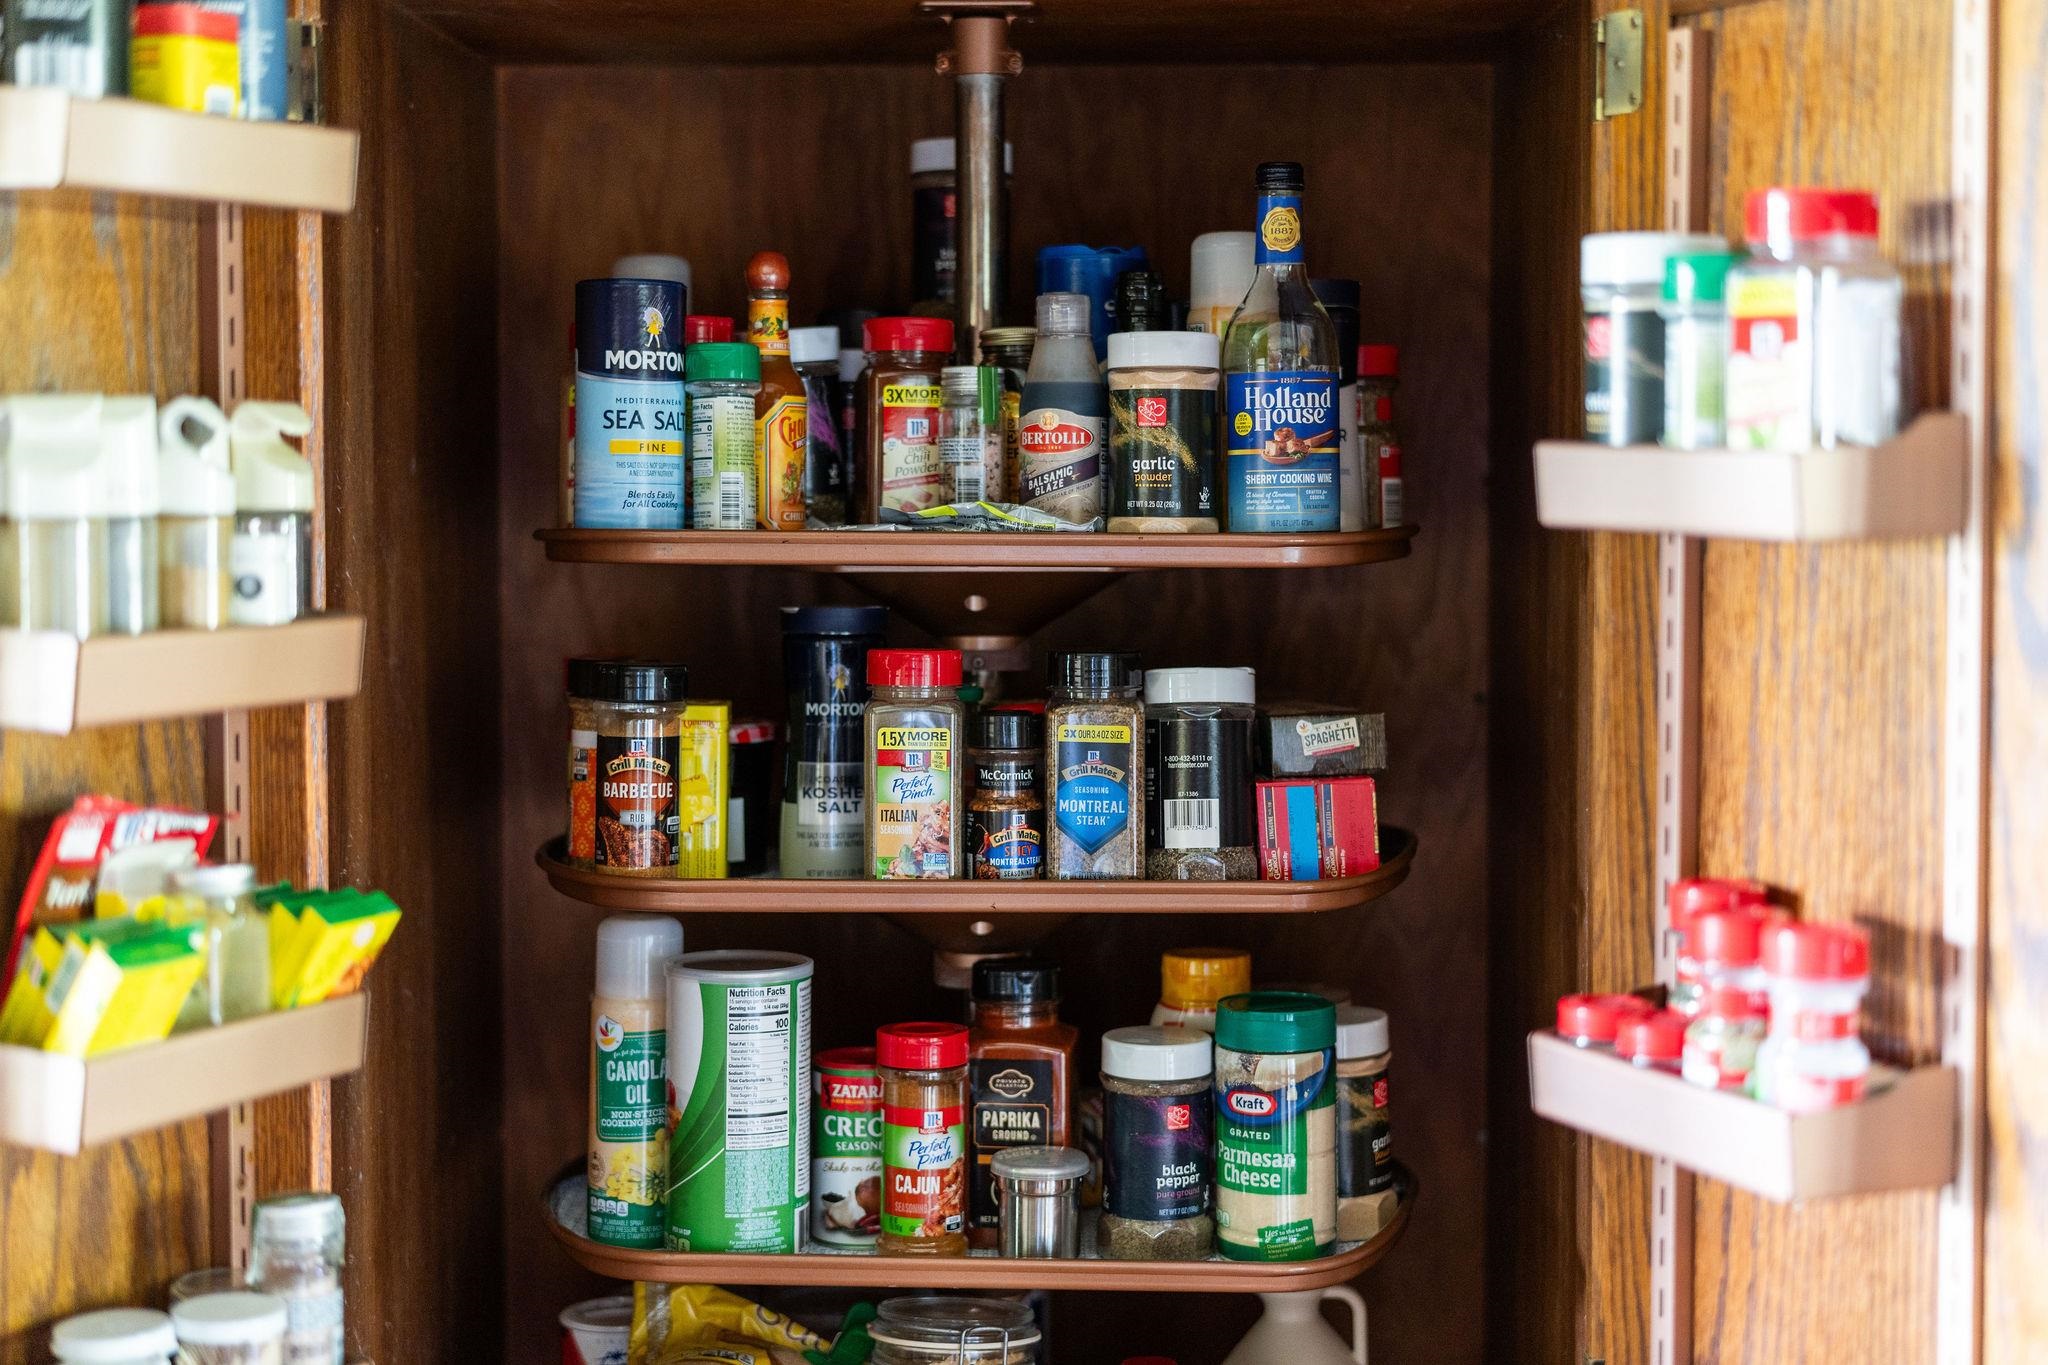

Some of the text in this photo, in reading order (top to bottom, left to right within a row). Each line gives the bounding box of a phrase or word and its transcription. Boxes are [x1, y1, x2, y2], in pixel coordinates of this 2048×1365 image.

[605, 350, 685, 372] MORTON
[616, 398, 682, 406] MEDITERRANEAN
[886, 388, 940, 404] 3X MOR
[1244, 386, 1331, 410] Holland
[603, 410, 685, 432] SEA SALT
[1254, 407, 1326, 432] House
[1022, 432, 1086, 446] BERTOLLI
[640, 443, 666, 452] FINE
[904, 451, 930, 465] Chili
[1132, 456, 1176, 473] garlic
[895, 464, 939, 478] Powder
[1028, 465, 1073, 490] BALSAMIC
[1134, 472, 1172, 483] powder
[1246, 472, 1332, 485] SHERRY COOKING WINE
[1034, 480, 1064, 496] GLAZE
[628, 490, 676, 502] Blends Easily
[622, 500, 679, 510] for All Cooking
[805, 702, 866, 716] MORTON
[881, 732, 948, 746] 1.5X MORE
[1064, 730, 1124, 740] 3X OUR 3.4 OZ SIZE
[1304, 726, 1356, 747] SPAGHETTI
[610, 758, 666, 773] Grill Mates
[1069, 766, 1118, 778] Grill Mates
[980, 768, 1033, 780] McCormick
[892, 774, 933, 792] Perfect
[603, 782, 674, 799] BARBECUE
[803, 786, 864, 799] KOSHE
[900, 783, 932, 804] Pinch
[818, 801, 860, 814] SALT
[1060, 800, 1126, 814] MONTREAL
[630, 814, 645, 822] RUB
[880, 810, 918, 822] ITALIAN
[1076, 815, 1106, 826] STEAK
[880, 824, 913, 834] SEASONING
[1267, 816, 1275, 840] LINGUINE
[993, 830, 1039, 844] Grill Mates
[1004, 845, 1032, 857] SPICY
[990, 857, 1026, 866] MONTREAL
[1272, 850, 1280, 880] GIORGIO
[1329, 848, 1338, 878] GIORGIO
[1004, 868, 1033, 878] SEASONING
[729, 987, 786, 998] Nutrition Facts
[728, 1017, 789, 1031] Calories 100
[606, 1058, 666, 1082] CANOLA
[626, 1084, 651, 1104] OIL
[1236, 1096, 1264, 1110] Kraft
[610, 1108, 665, 1119] NON-STICK
[982, 1110, 1040, 1128] PAPRIKA
[602, 1118, 644, 1127] COOKING
[824, 1114, 884, 1138] CREO
[992, 1130, 1030, 1140] GROUND
[1230, 1128, 1271, 1140] GRATED
[836, 1141, 883, 1152] SEASON
[908, 1136, 950, 1156] Perfect
[917, 1146, 951, 1170] Pinch
[1218, 1140, 1296, 1168] Parmesan
[824, 1161, 848, 1173] Shake
[1162, 1162, 1197, 1176] black
[1156, 1172, 1200, 1190] pepper
[1224, 1162, 1282, 1188] Cheese
[895, 1174, 940, 1194] CAJUN
[1156, 1187, 1200, 1200] pure ground
[894, 1202, 928, 1212] SEASONING
[1264, 1230, 1278, 1243] Yes
